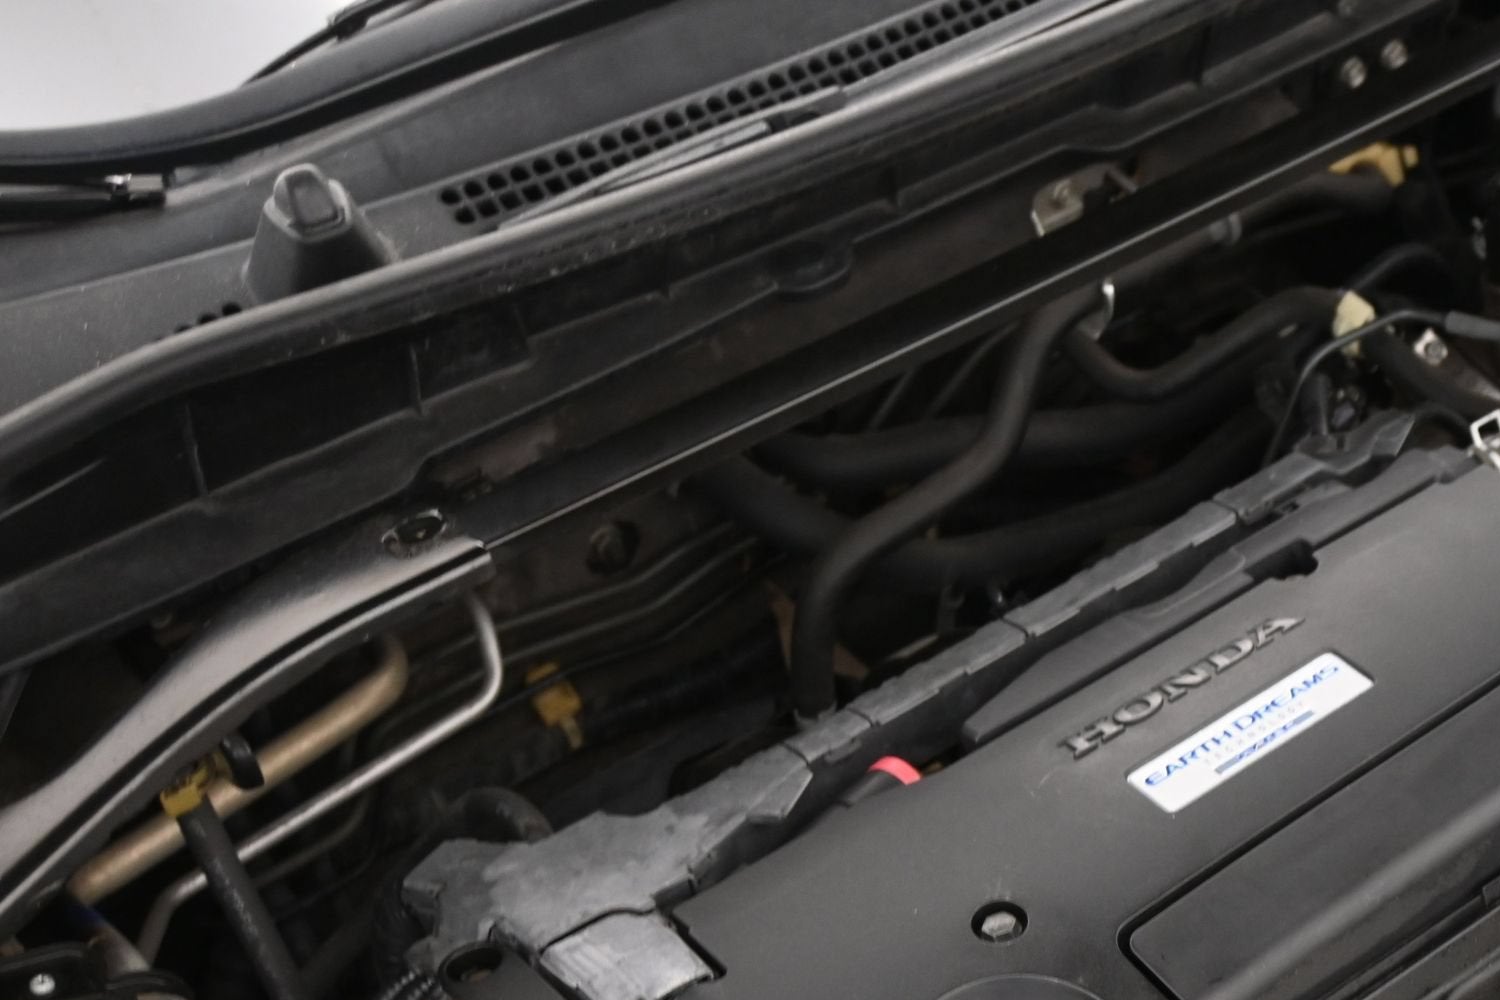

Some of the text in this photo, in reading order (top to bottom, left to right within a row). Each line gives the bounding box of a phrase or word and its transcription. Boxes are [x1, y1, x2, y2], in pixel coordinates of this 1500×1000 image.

[1058, 617, 1305, 760] HONDA
[1145, 729, 1234, 786] EARTH
[1234, 664, 1340, 731] DREAMS
